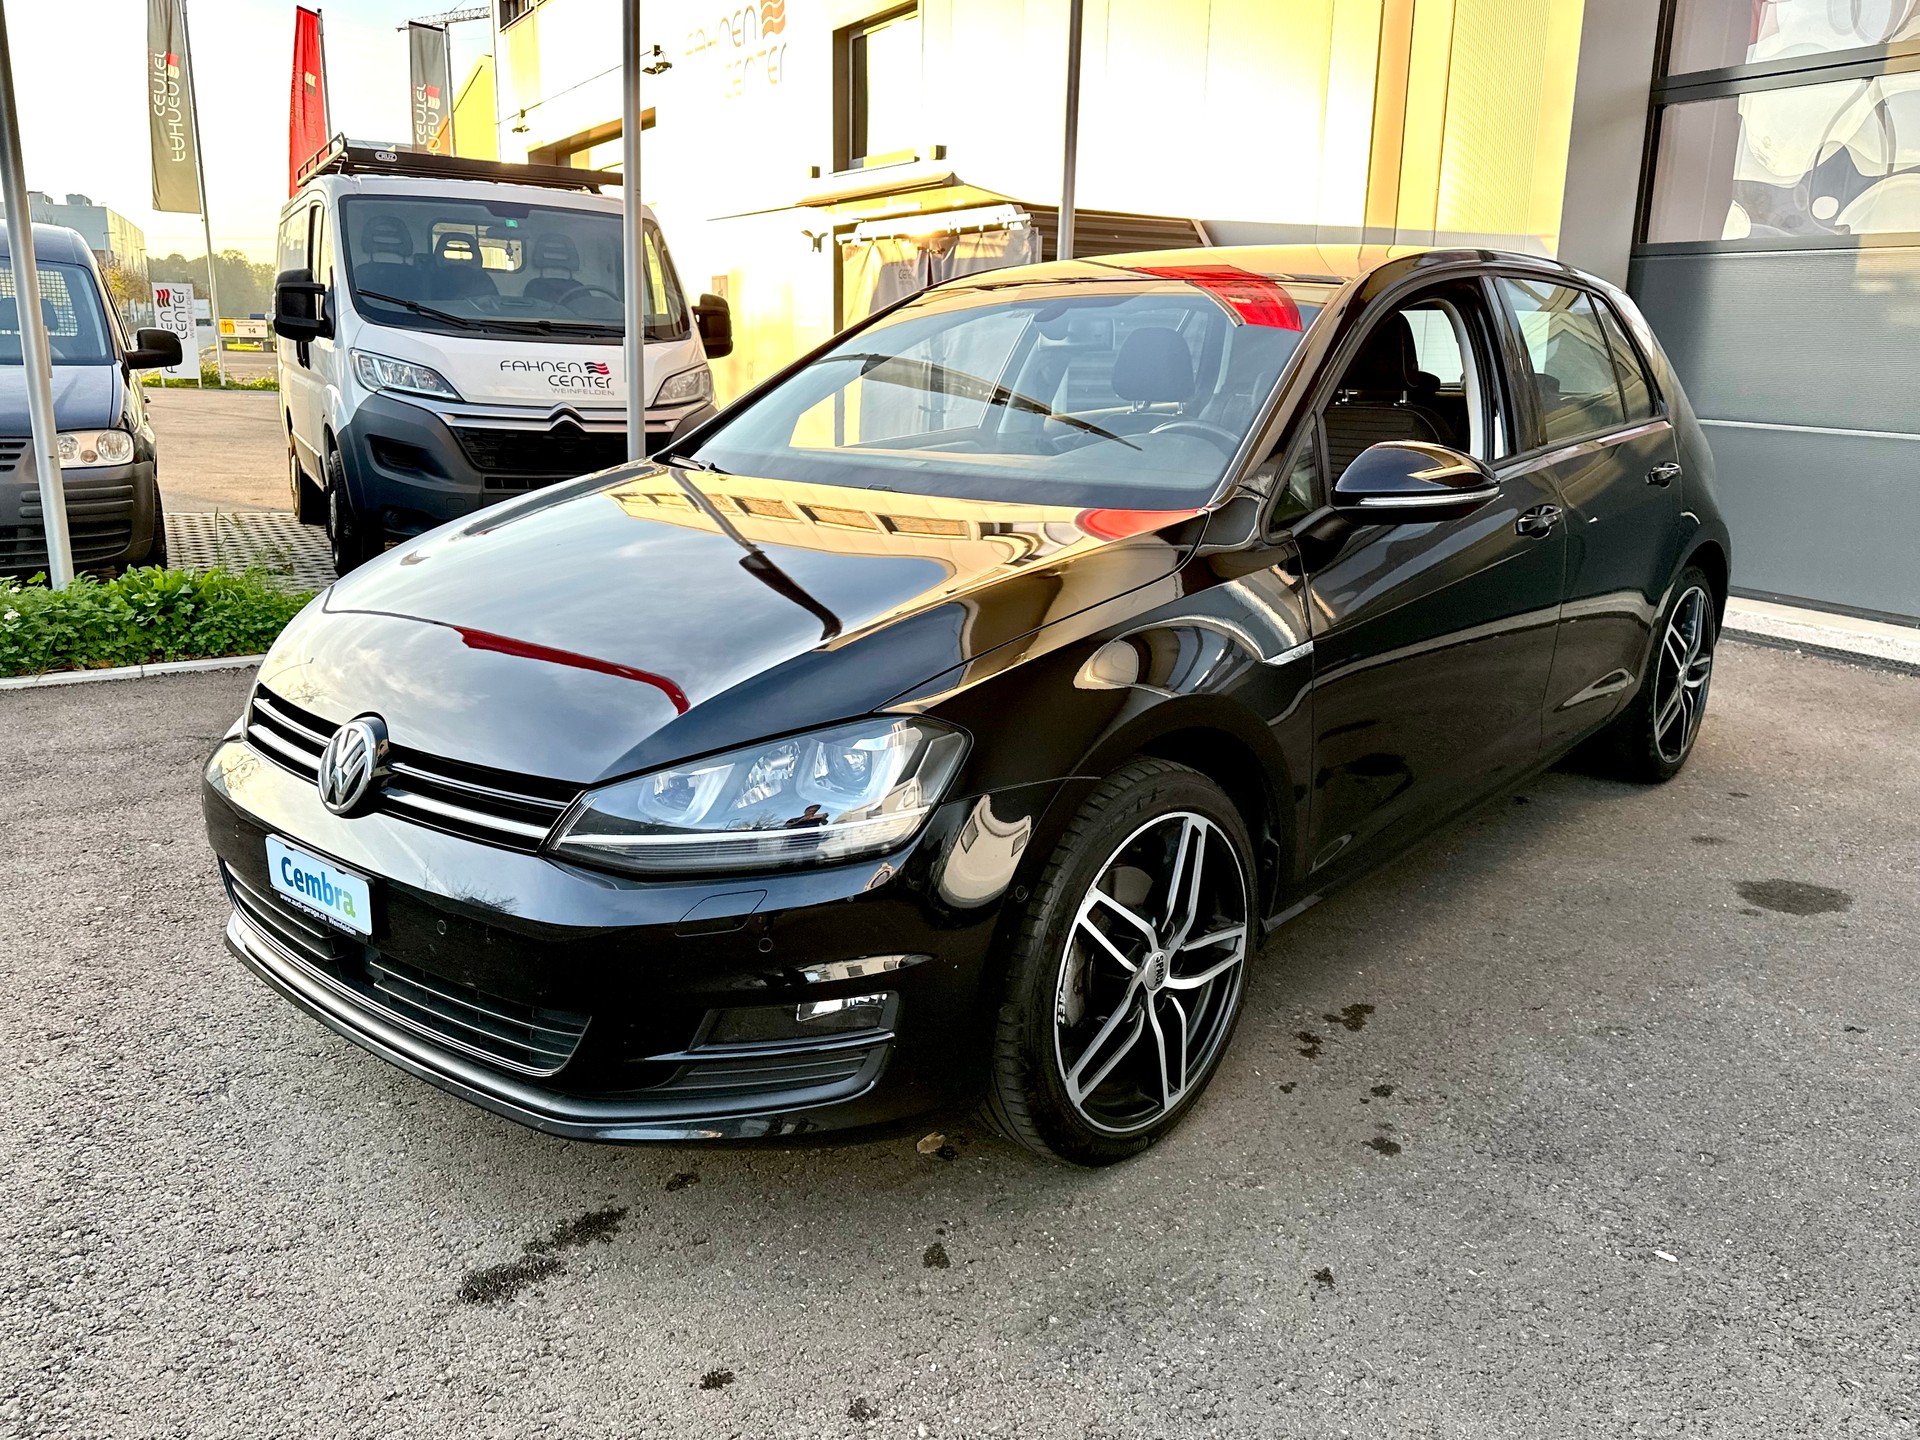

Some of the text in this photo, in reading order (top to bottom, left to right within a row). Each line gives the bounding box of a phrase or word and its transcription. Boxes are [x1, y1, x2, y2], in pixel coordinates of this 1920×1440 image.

[500, 360, 583, 373] FAHNEN
[548, 374, 612, 389] CENTER
[551, 387, 615, 396] WEINFELDEN
[281, 856, 356, 919] Cembra
[1154, 955, 1165, 987] SPACE
